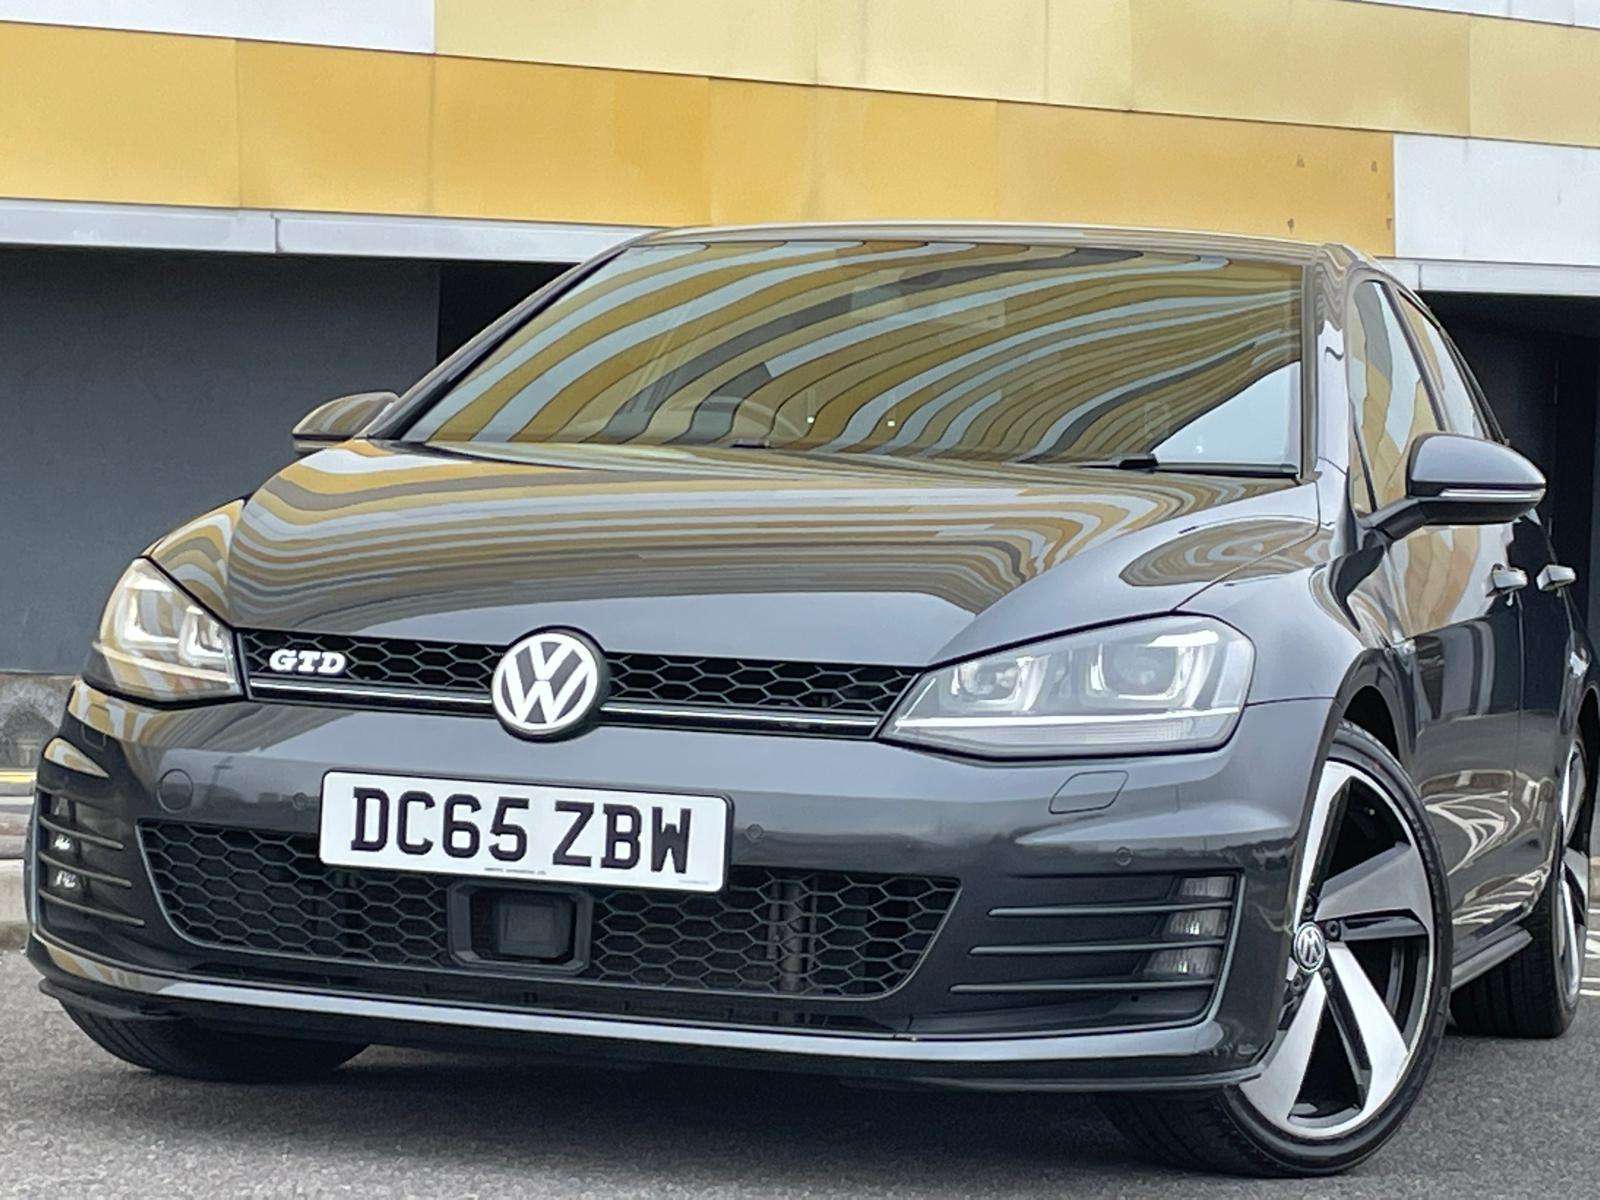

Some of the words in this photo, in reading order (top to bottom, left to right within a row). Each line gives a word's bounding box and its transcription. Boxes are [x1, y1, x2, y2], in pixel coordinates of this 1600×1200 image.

[269, 649, 347, 675] GTD
[495, 634, 598, 729] VW
[350, 786, 530, 862] DC65
[552, 800, 692, 874] ZBW
